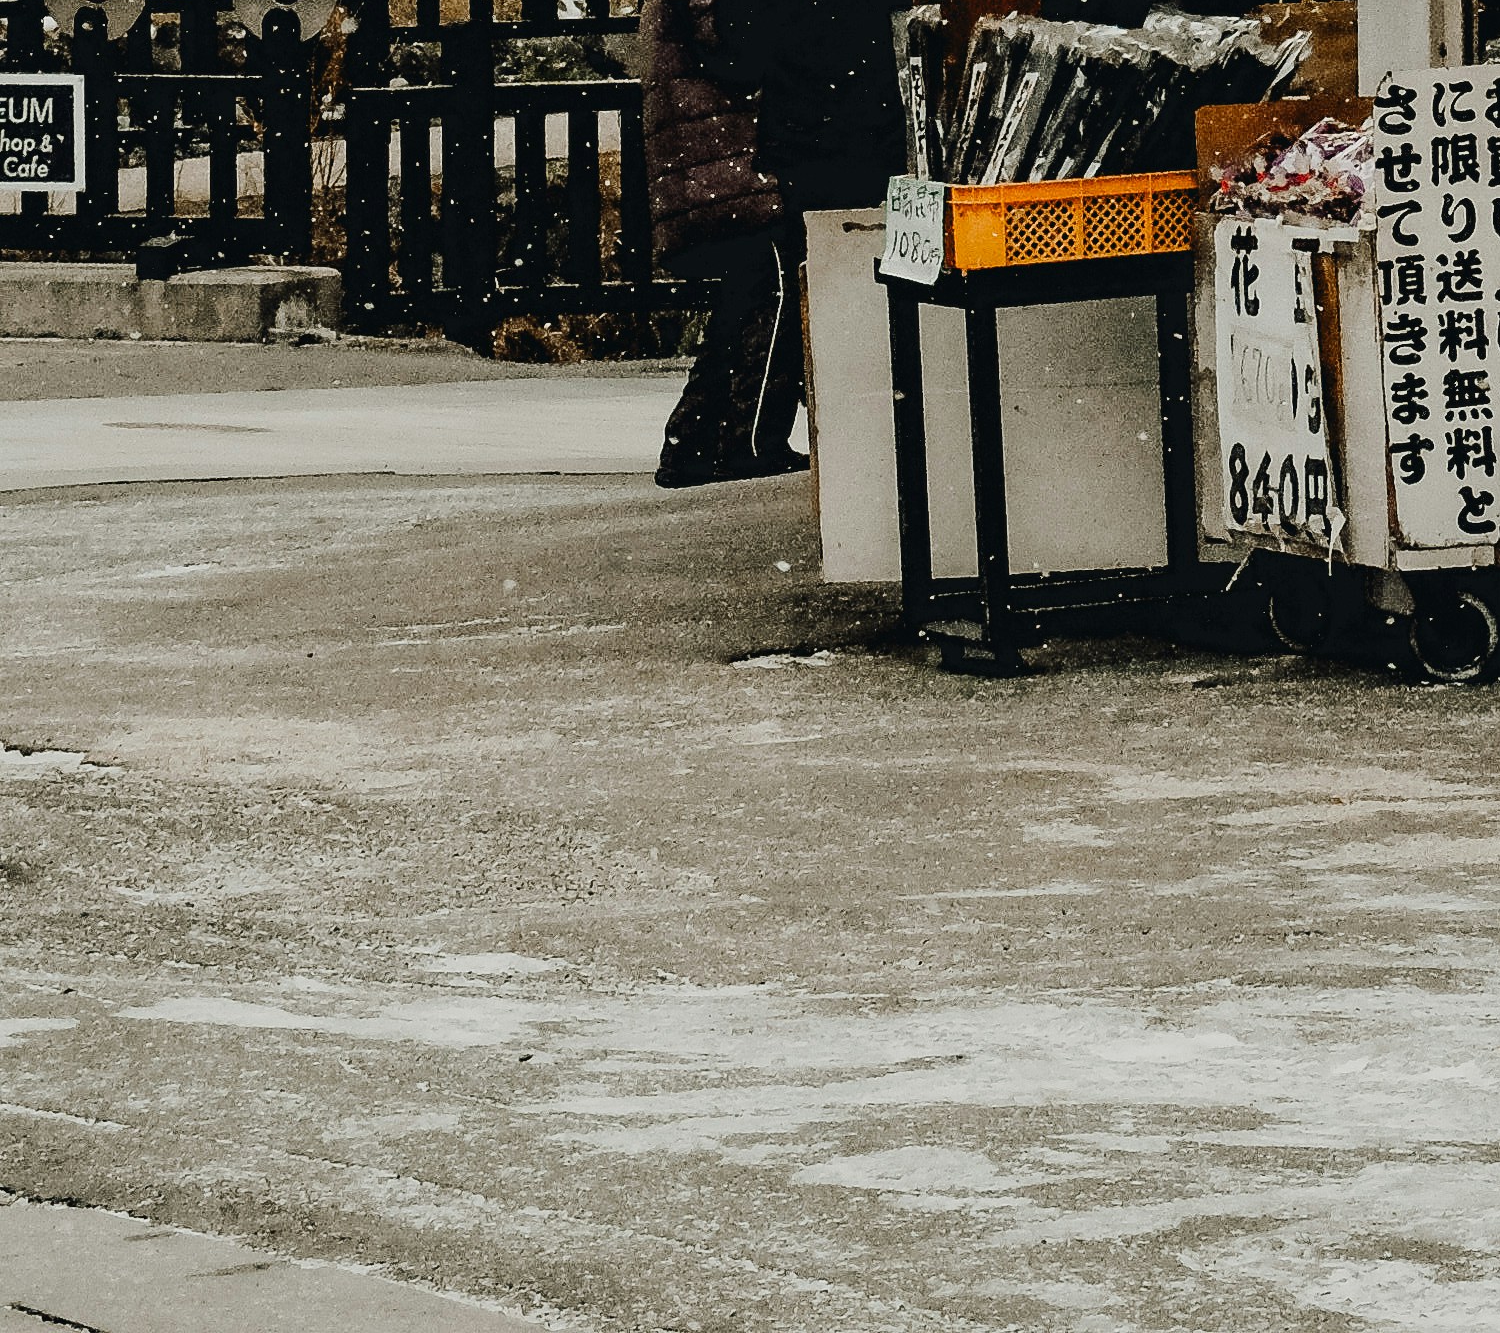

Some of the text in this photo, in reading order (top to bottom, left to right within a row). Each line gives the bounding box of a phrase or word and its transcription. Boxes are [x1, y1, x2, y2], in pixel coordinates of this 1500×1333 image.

[4, 155, 49, 177] Cafe
[1374, 84, 1435, 485] させて頂きます
[1431, 80, 1498, 535] に限り送料無料と
